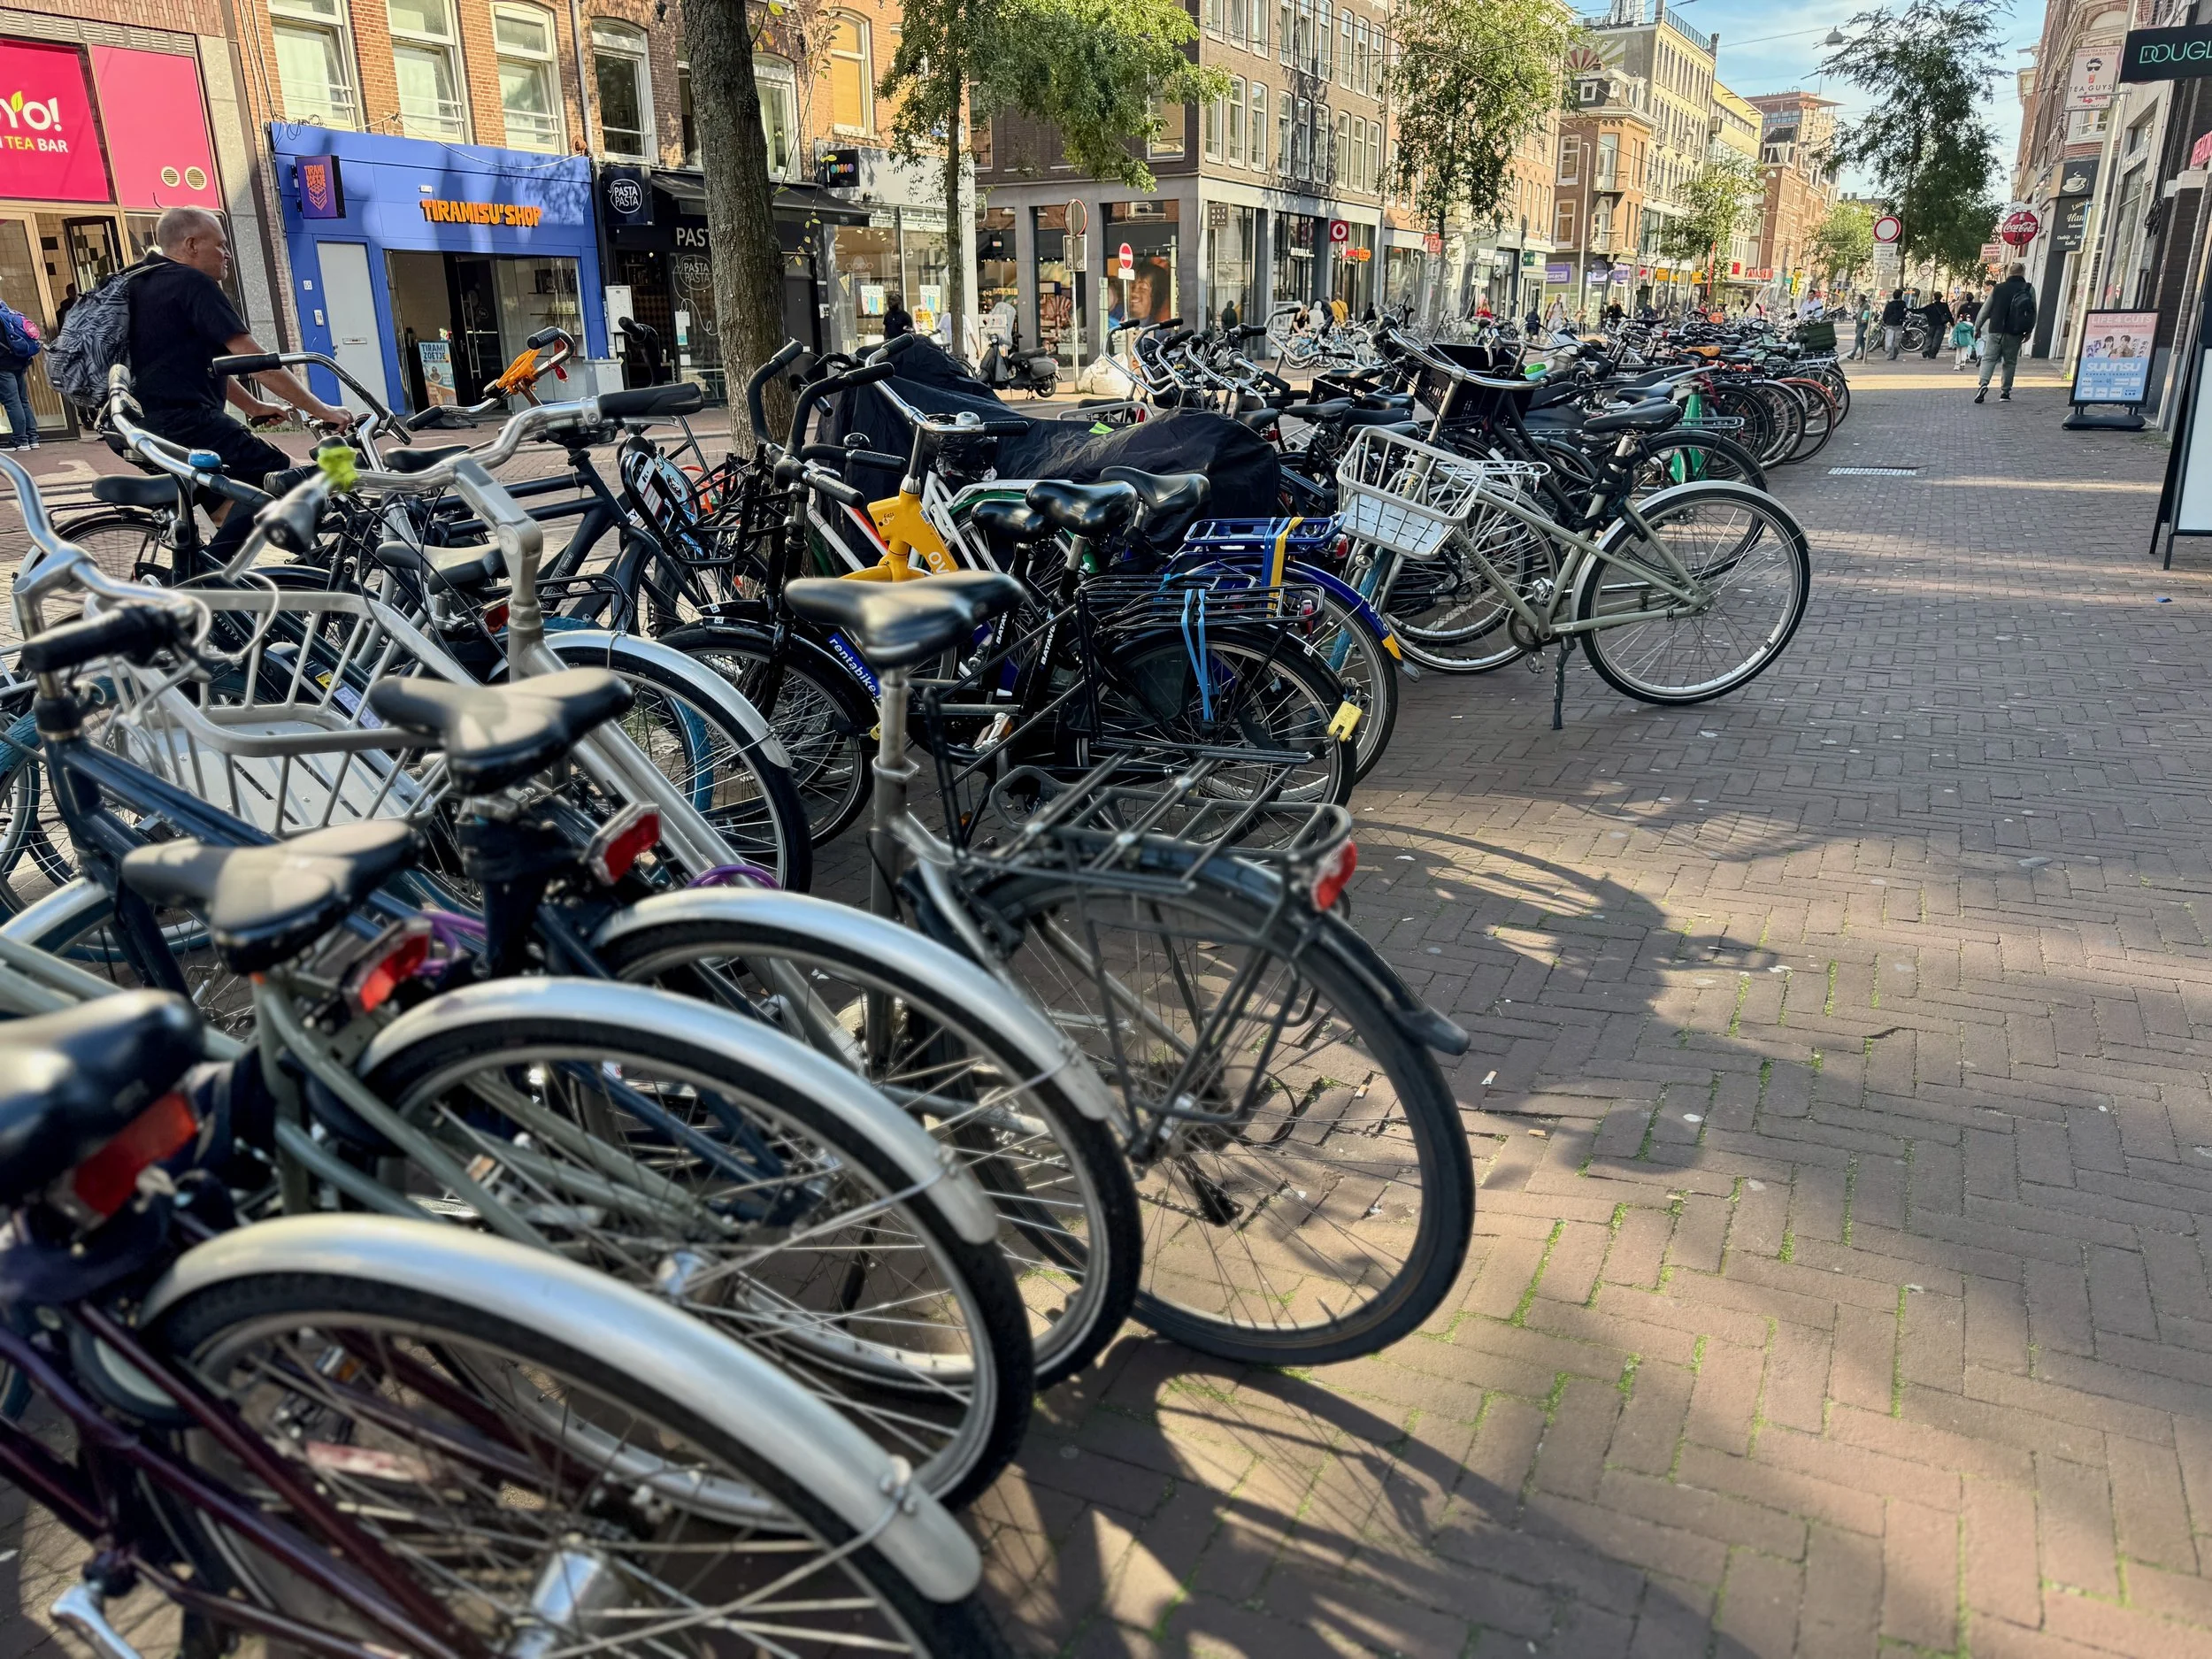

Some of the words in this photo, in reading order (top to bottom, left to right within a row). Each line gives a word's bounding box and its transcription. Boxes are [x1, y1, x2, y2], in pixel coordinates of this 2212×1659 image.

[0, 97, 62, 132] YO!
[4, 136, 35, 150] TEA
[37, 138, 69, 153] BAR
[304, 164, 325, 178] TIRAMI
[614, 186, 638, 197] PASTA
[615, 196, 639, 207] PASTA
[684, 262, 709, 273] PASTA
[685, 273, 710, 283] PASTA
[421, 343, 445, 353] TIRAMI
[996, 611, 1009, 645] BATAV
[1041, 623, 1057, 665] BATAVU
